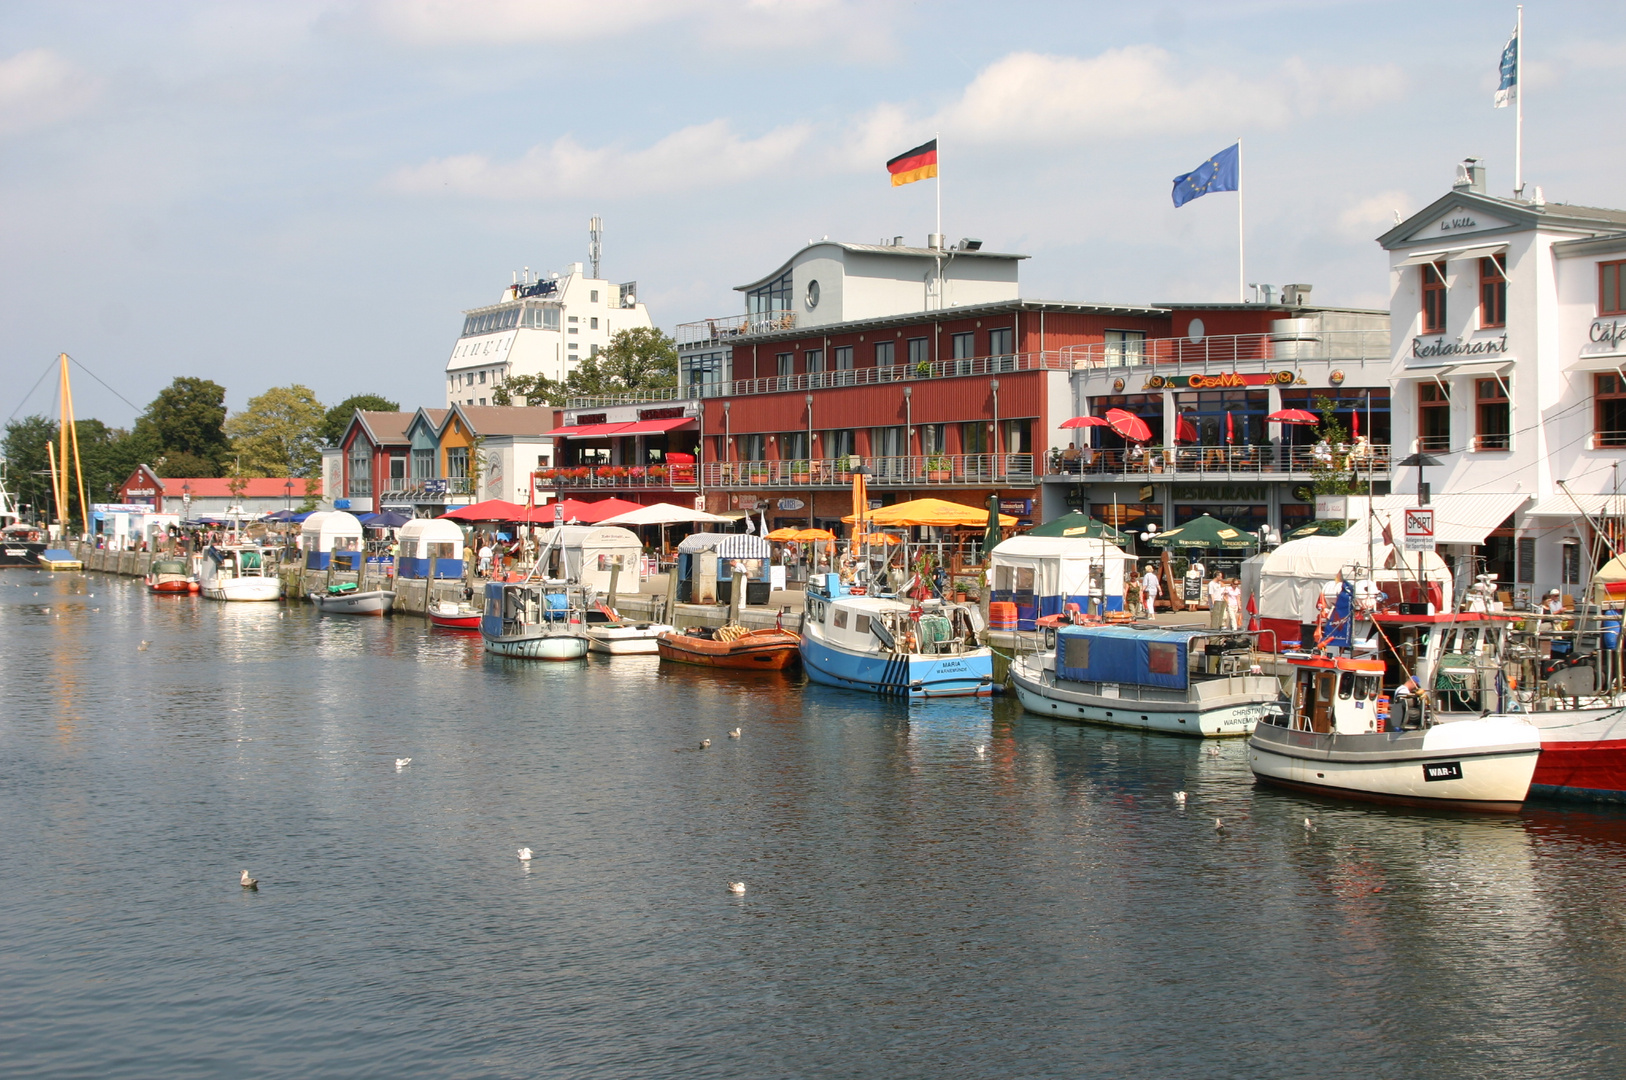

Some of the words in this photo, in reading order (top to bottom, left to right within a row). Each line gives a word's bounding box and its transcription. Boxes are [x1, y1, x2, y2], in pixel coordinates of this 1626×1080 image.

[1441, 221, 1450, 231] La
[1452, 217, 1476, 229] Villa
[1412, 333, 1508, 358] Restaurant
[1171, 484, 1267, 501] RESTAURANT
[1408, 516, 1431, 529] SPORT
[1231, 707, 1263, 717] CHRISTIN
[1428, 766, 1457, 777] WAR-1
